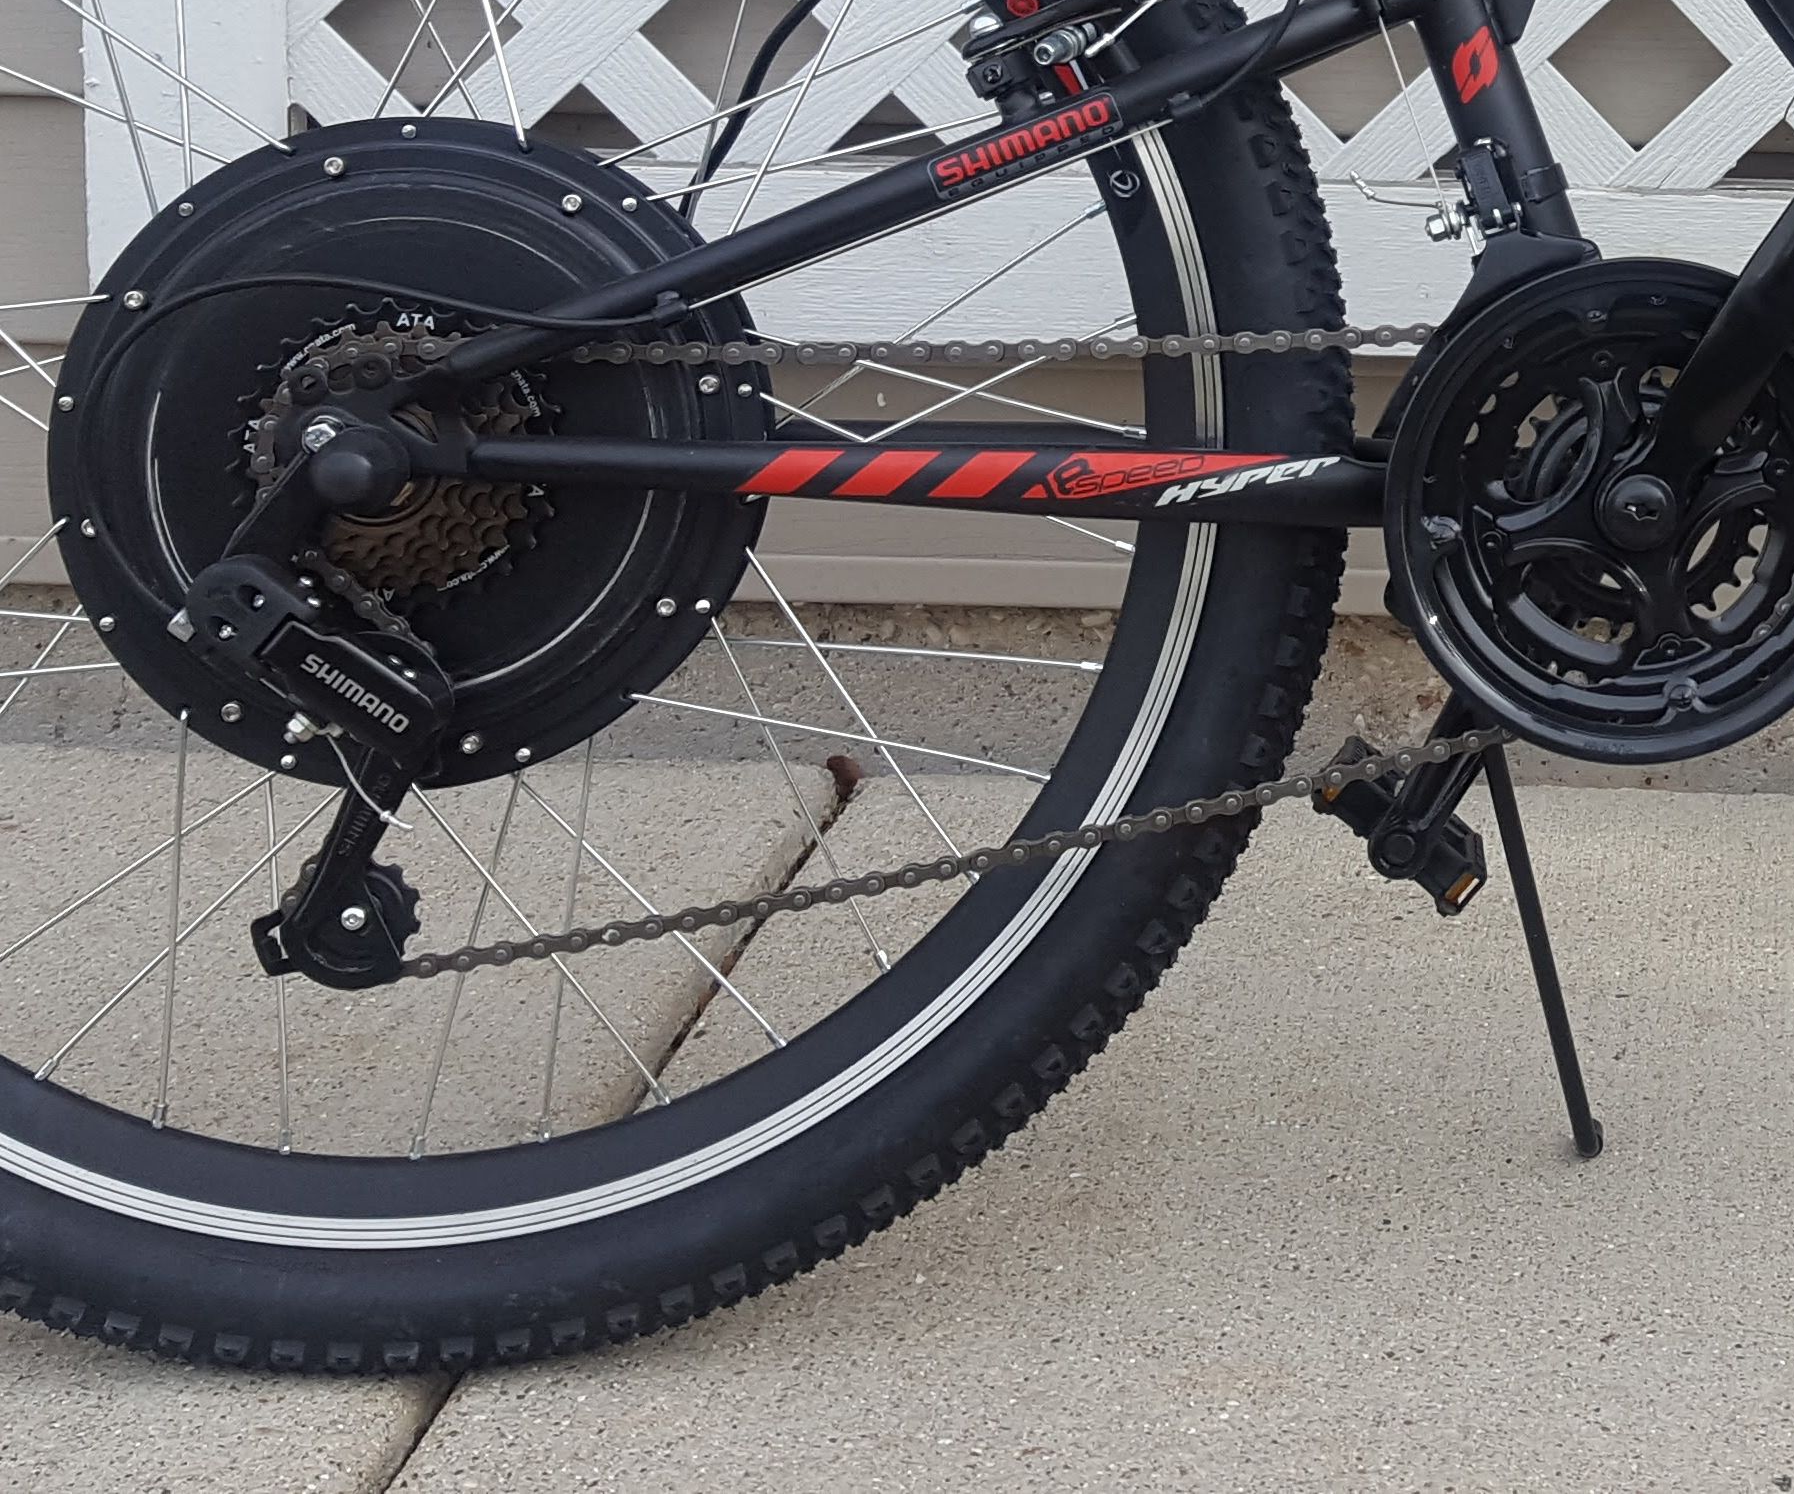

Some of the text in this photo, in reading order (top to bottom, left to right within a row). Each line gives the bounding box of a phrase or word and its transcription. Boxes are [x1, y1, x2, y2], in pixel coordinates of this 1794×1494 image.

[934, 96, 1111, 186] SHIMANO
[396, 312, 436, 330] ATA
[299, 651, 412, 735] SHIMANO
